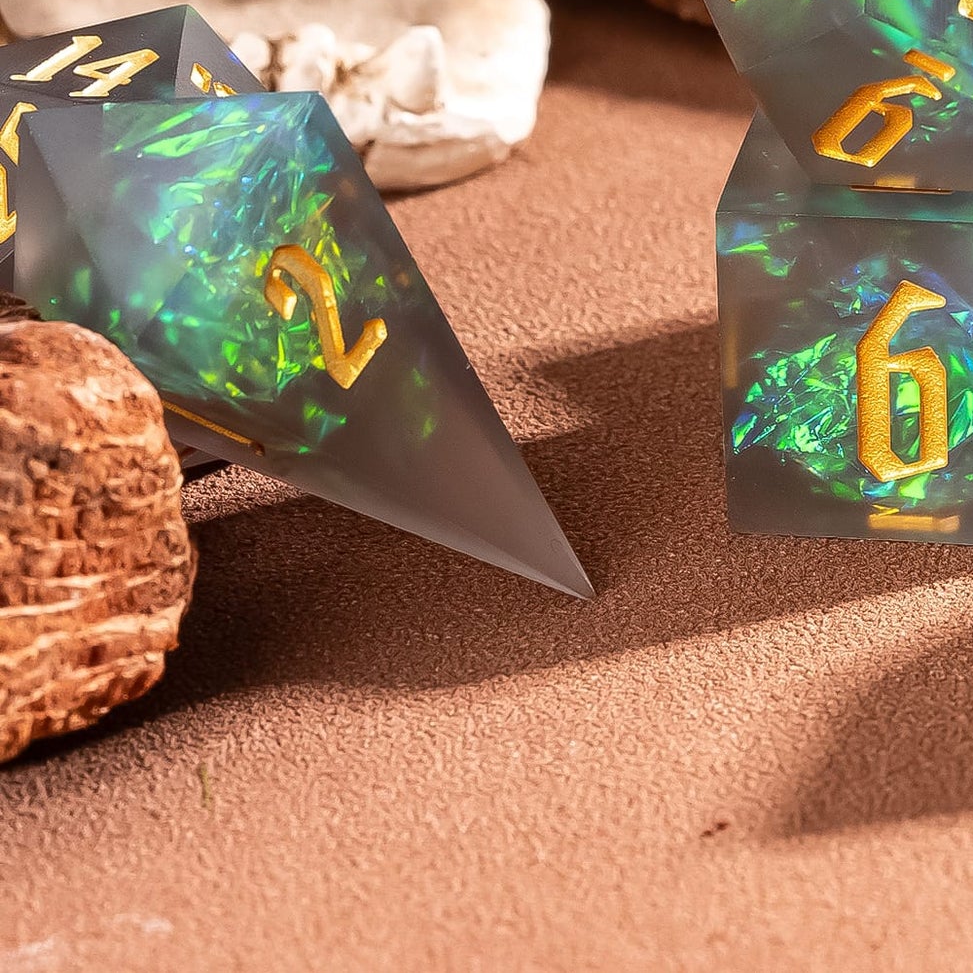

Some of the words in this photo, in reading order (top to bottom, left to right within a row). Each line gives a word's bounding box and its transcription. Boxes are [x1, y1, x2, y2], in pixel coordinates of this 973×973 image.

[10, 35, 160, 97] 14
[264, 244, 388, 389] 2
[856, 280, 948, 482] 6
